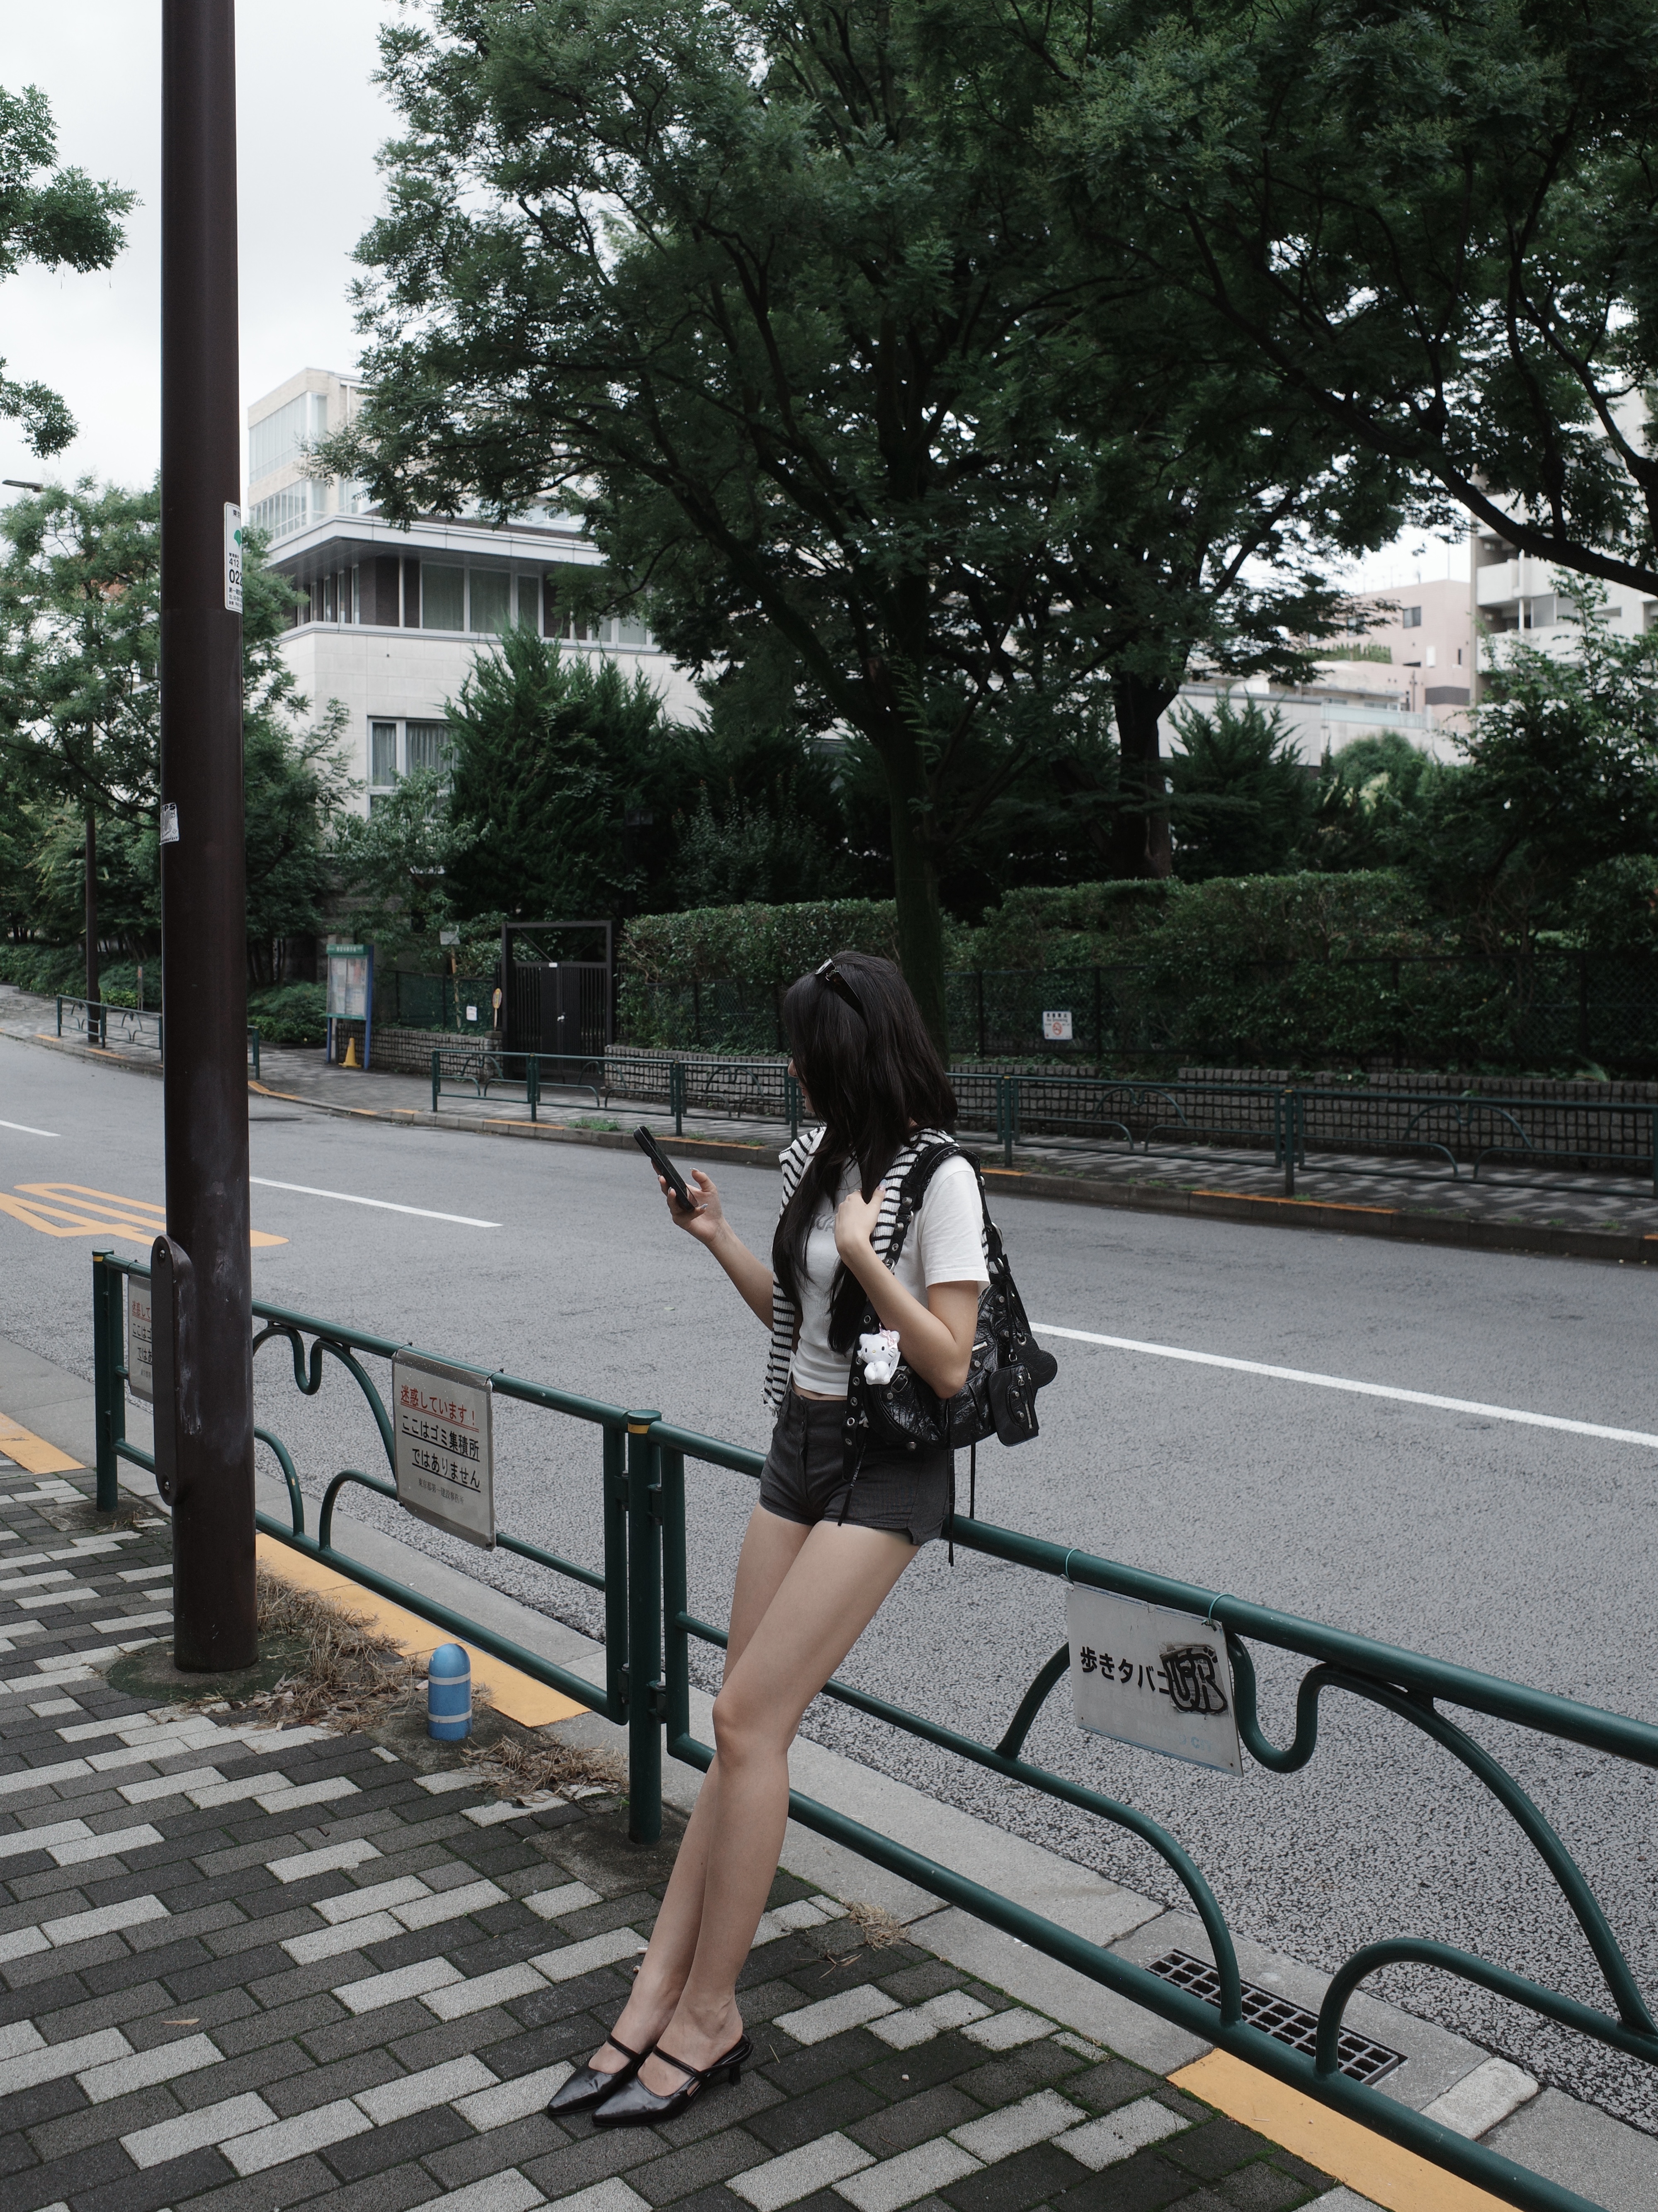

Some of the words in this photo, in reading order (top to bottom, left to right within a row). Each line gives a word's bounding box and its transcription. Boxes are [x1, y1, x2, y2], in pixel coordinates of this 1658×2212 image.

[229, 558, 239, 567] 412
[401, 1385, 474, 1426] 迷惑しています！
[403, 1415, 479, 1459] ここはゴミ集積所
[412, 1449, 480, 1488] ではありません
